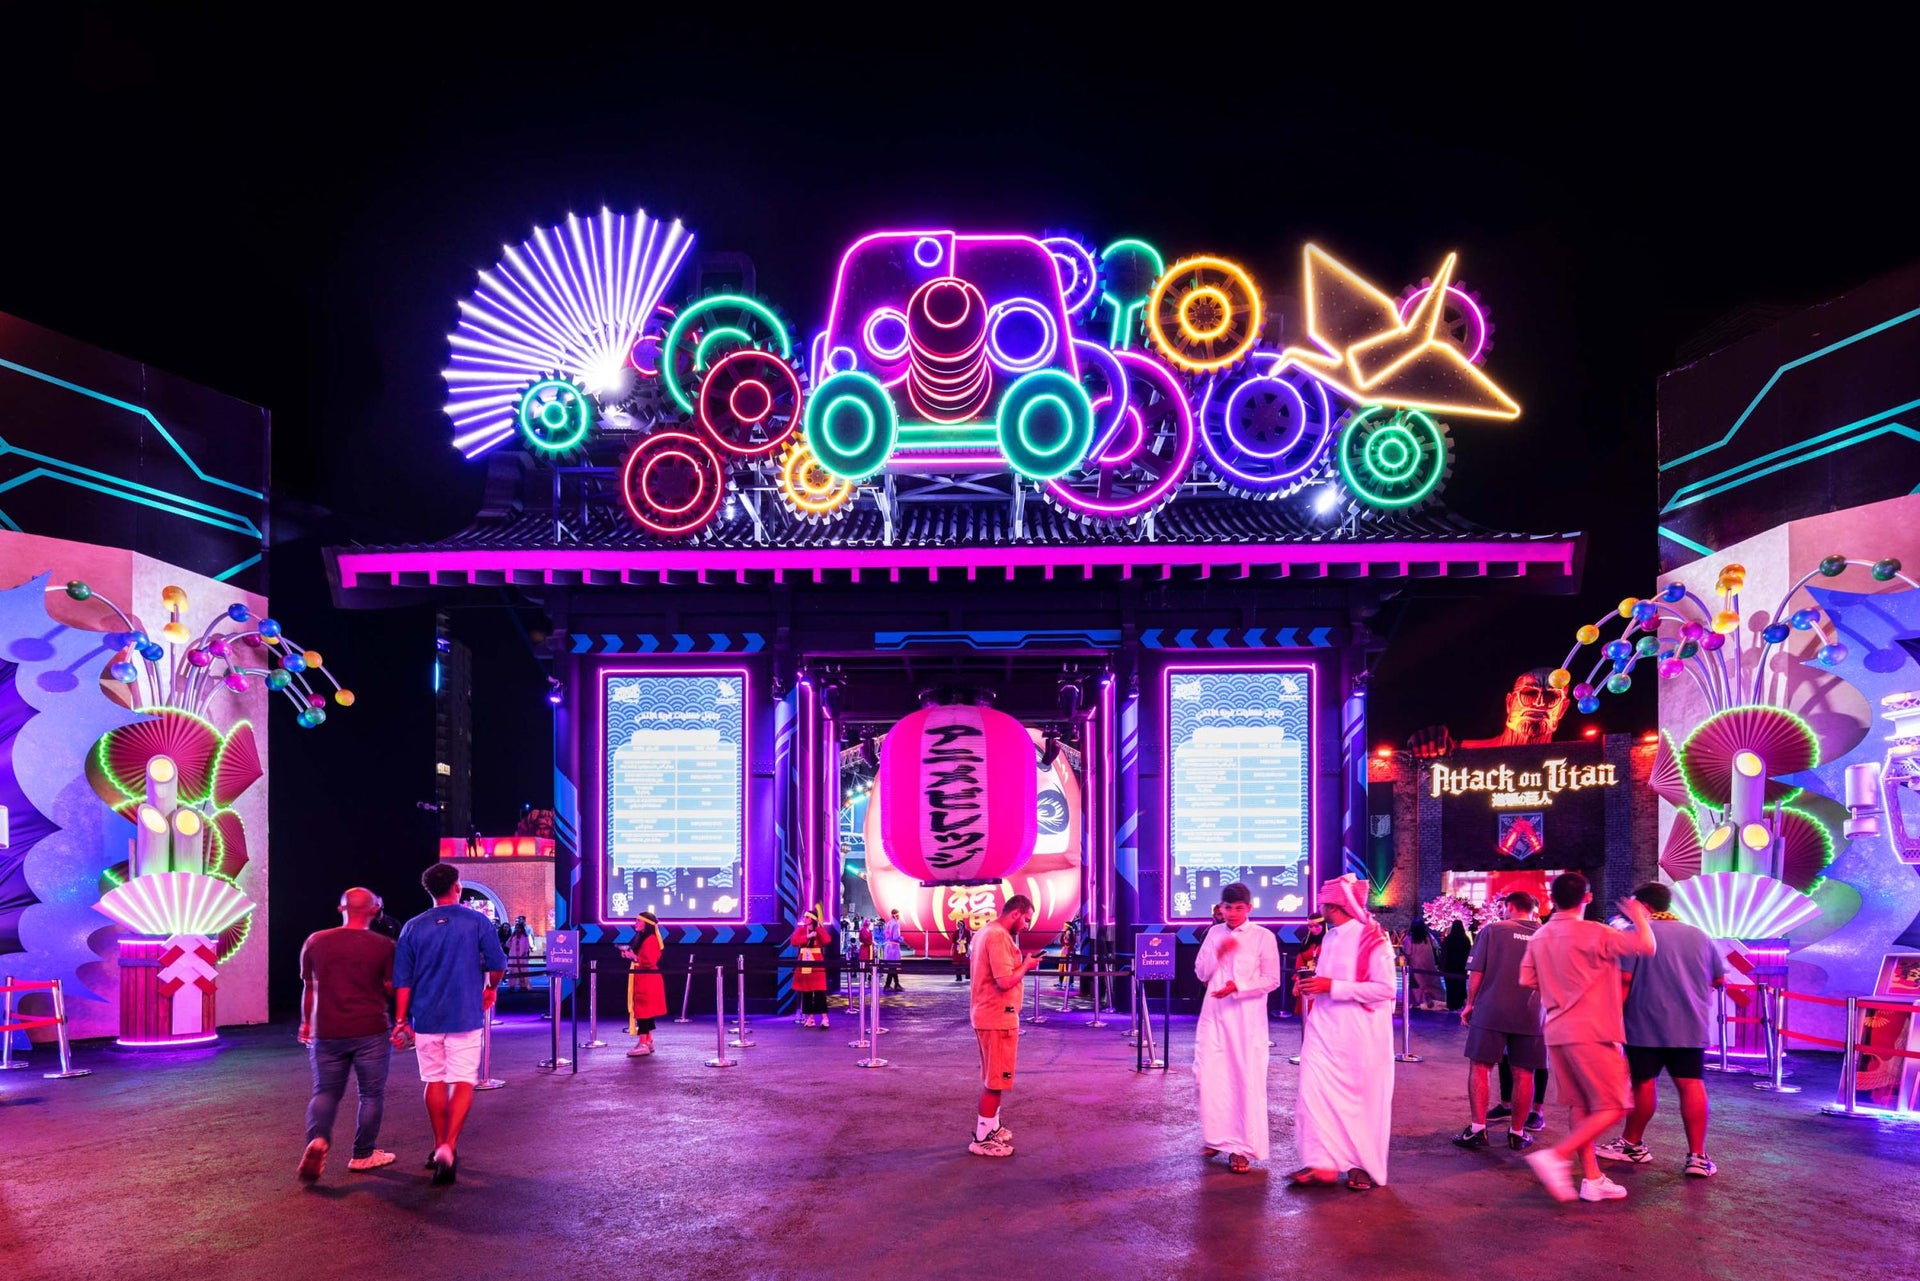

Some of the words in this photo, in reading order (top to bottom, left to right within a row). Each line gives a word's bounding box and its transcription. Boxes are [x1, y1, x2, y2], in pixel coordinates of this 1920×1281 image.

[1430, 762, 1516, 798] Attack
[1518, 772, 1542, 787] on
[1543, 757, 1619, 793] Titan
[947, 885, 998, 931] 福
